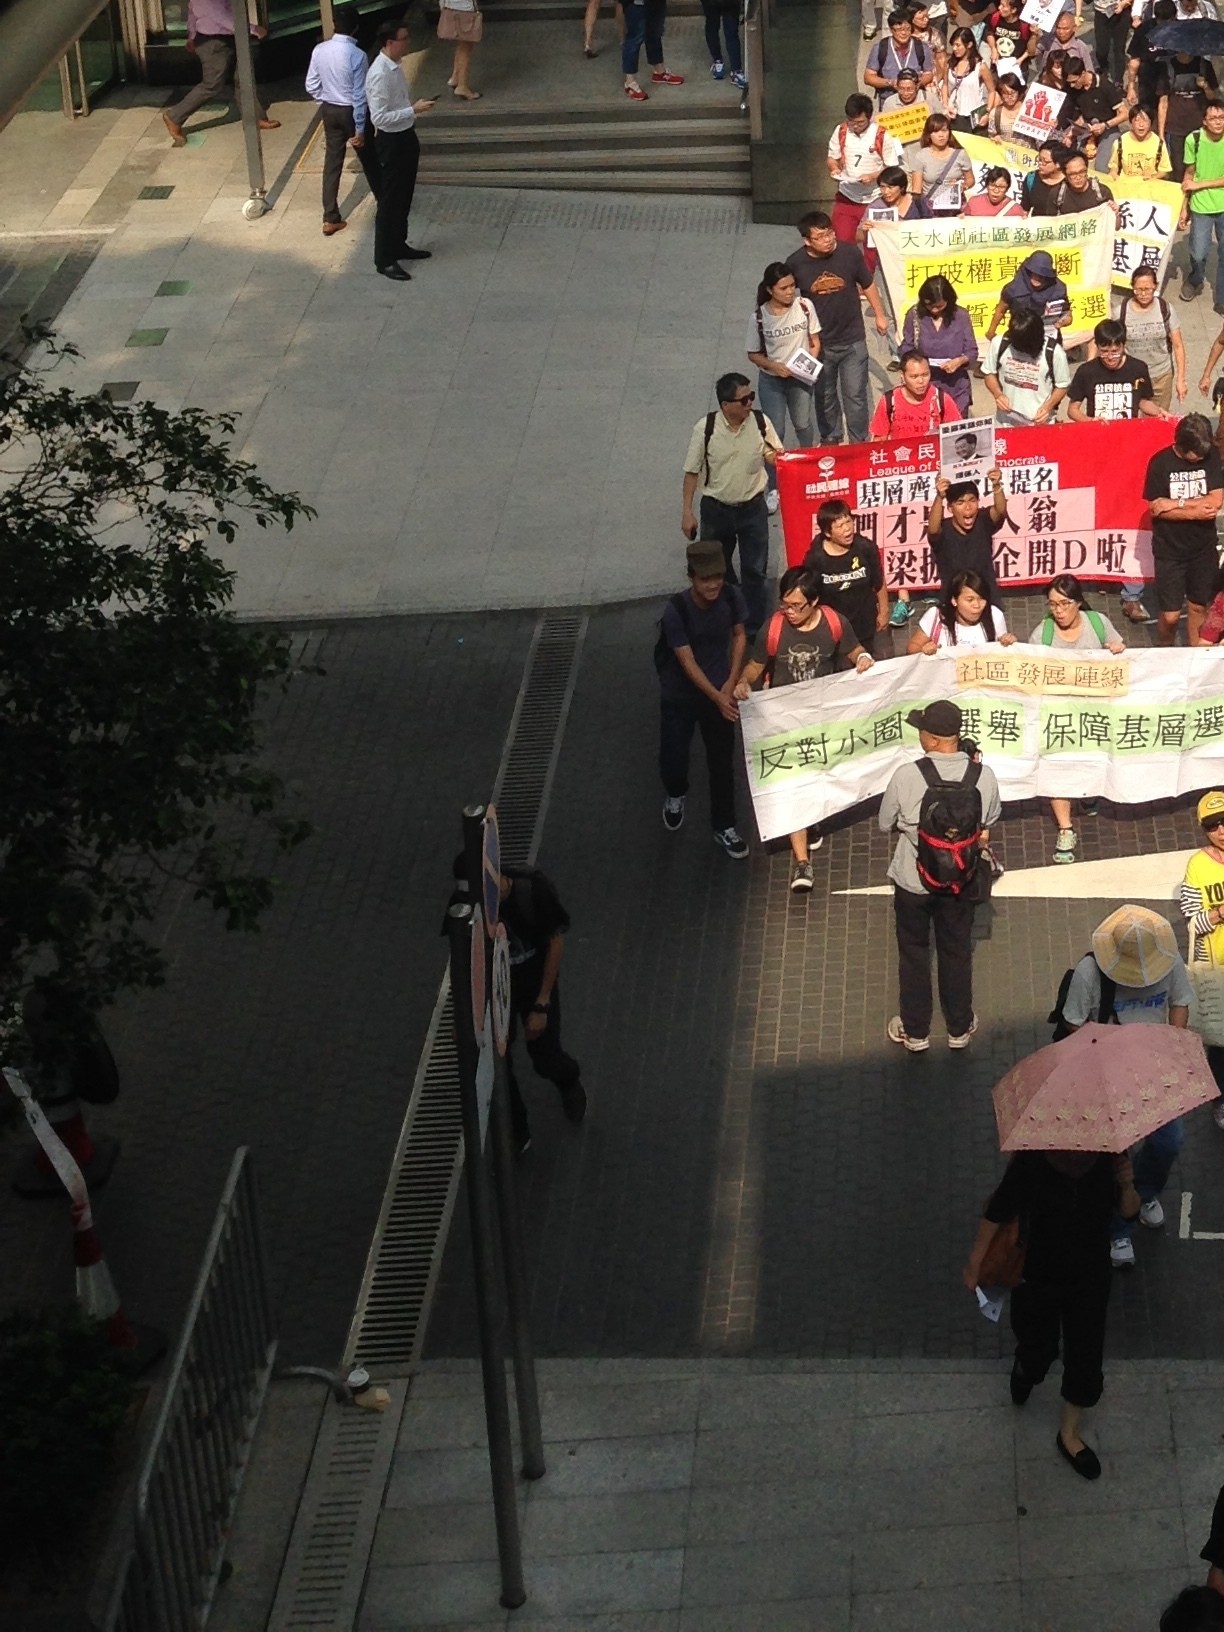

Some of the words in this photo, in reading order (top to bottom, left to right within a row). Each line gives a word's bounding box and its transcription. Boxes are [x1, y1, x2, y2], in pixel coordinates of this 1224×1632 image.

[906, 251, 1082, 289] 打破權貴斷
[869, 465, 917, 478] League
[918, 463, 933, 472] of
[999, 455, 1047, 468] mocrats
[959, 661, 1126, 690] 社區發展陣線
[758, 706, 1021, 781] 反對小圈選舉
